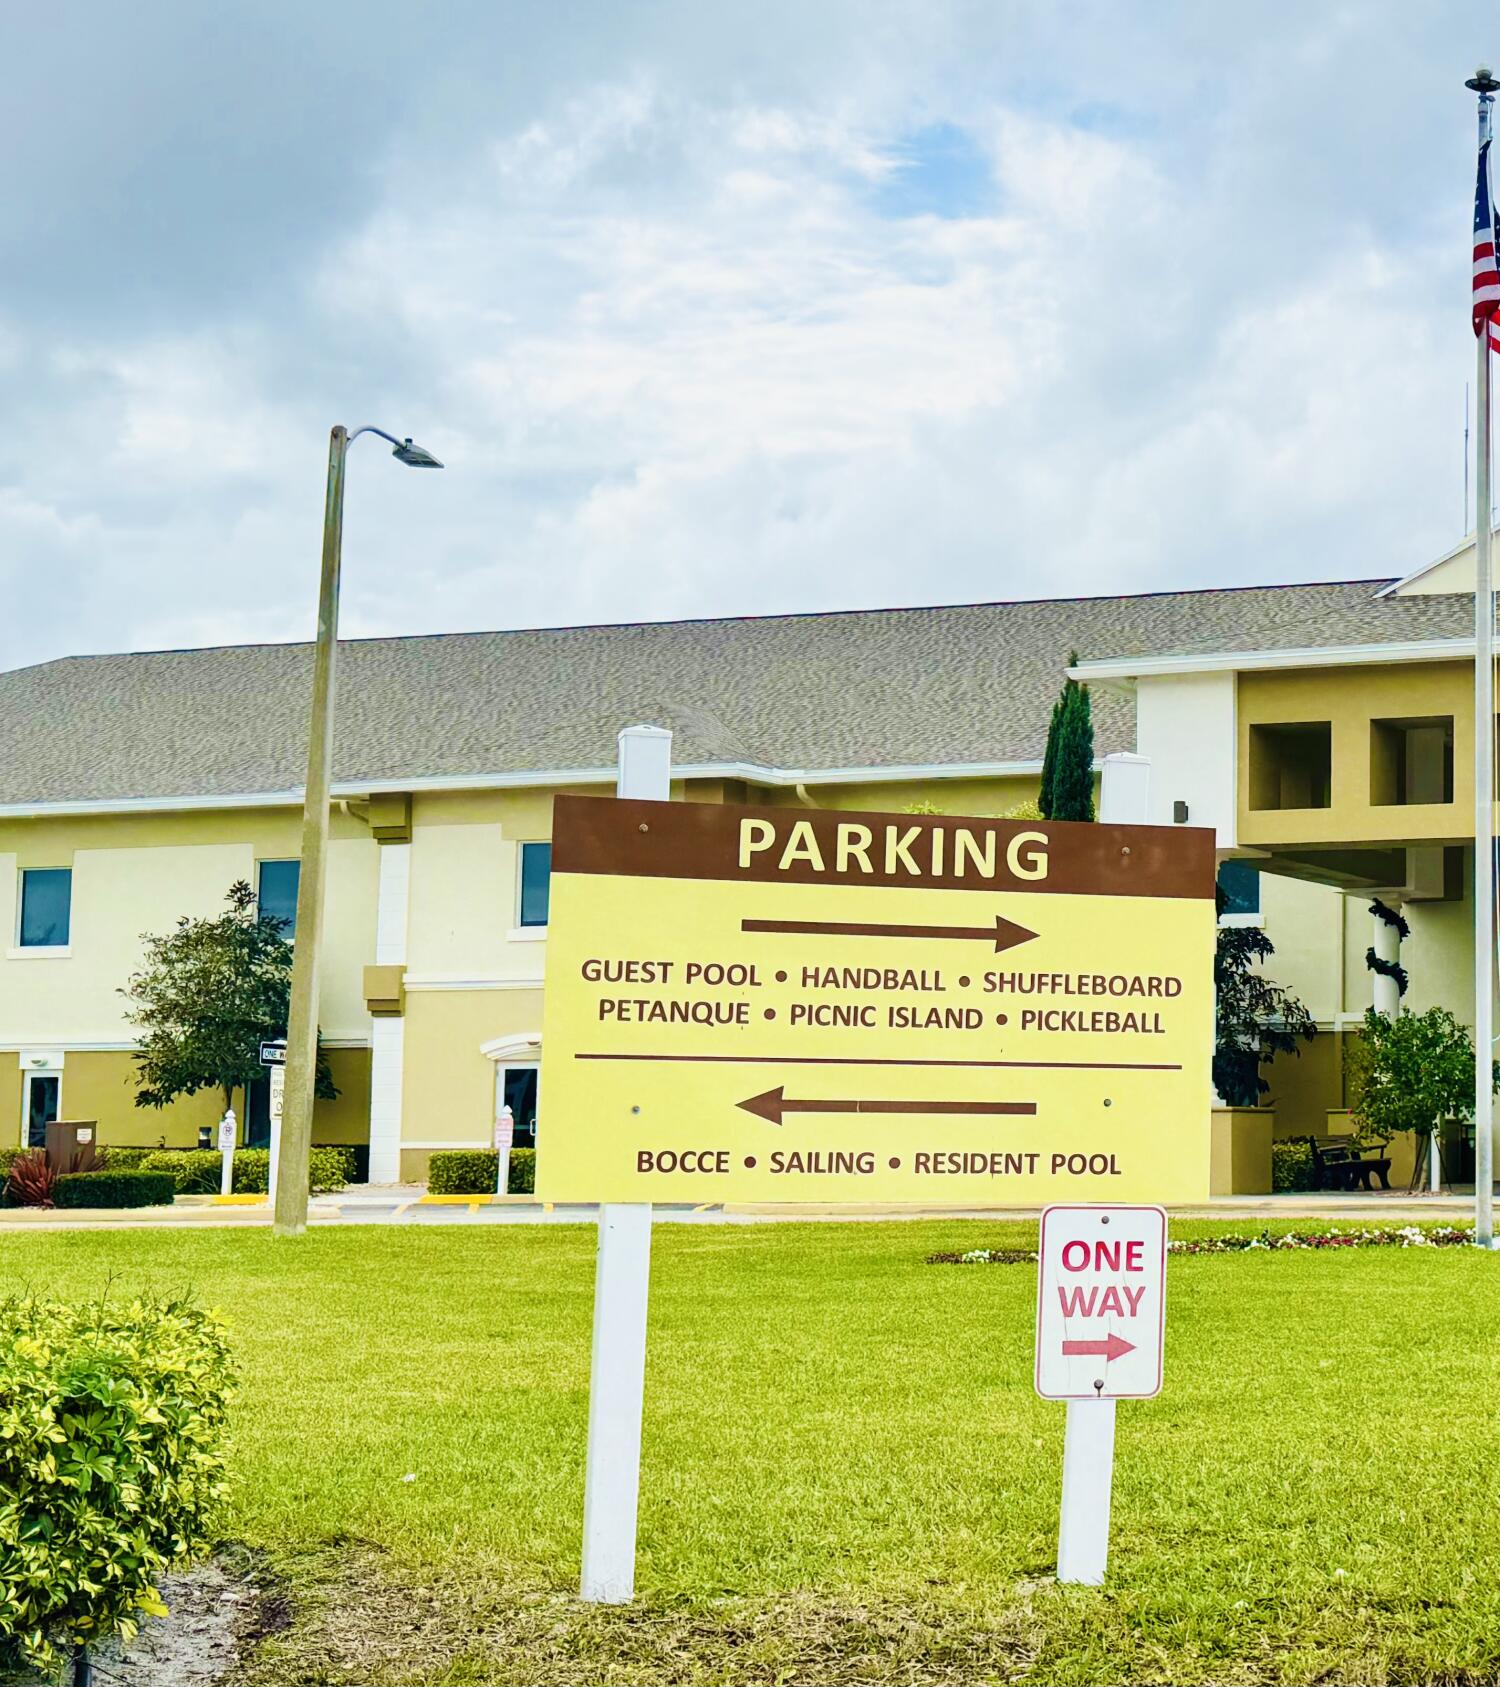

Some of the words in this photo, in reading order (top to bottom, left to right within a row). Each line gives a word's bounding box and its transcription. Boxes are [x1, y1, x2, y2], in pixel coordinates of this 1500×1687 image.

[738, 817, 1050, 881] PARKING
[581, 959, 674, 985] GUEST
[686, 962, 762, 987] POOL
[801, 966, 946, 992] HANDBALL
[983, 971, 1183, 998] SHUFFLEBOARD
[599, 998, 750, 1027] PETANQUE
[790, 1003, 877, 1028] PICNIC
[888, 1006, 984, 1029] ISLAND
[1021, 1009, 1166, 1034] PICKLEBALL
[637, 1150, 730, 1174] BOCCE
[769, 1151, 875, 1174] SAILING
[914, 1152, 1041, 1175] RESIDENT
[1051, 1153, 1122, 1176] POOL
[1061, 1240, 1145, 1272] ONE
[1057, 1286, 1146, 1318] WAY
